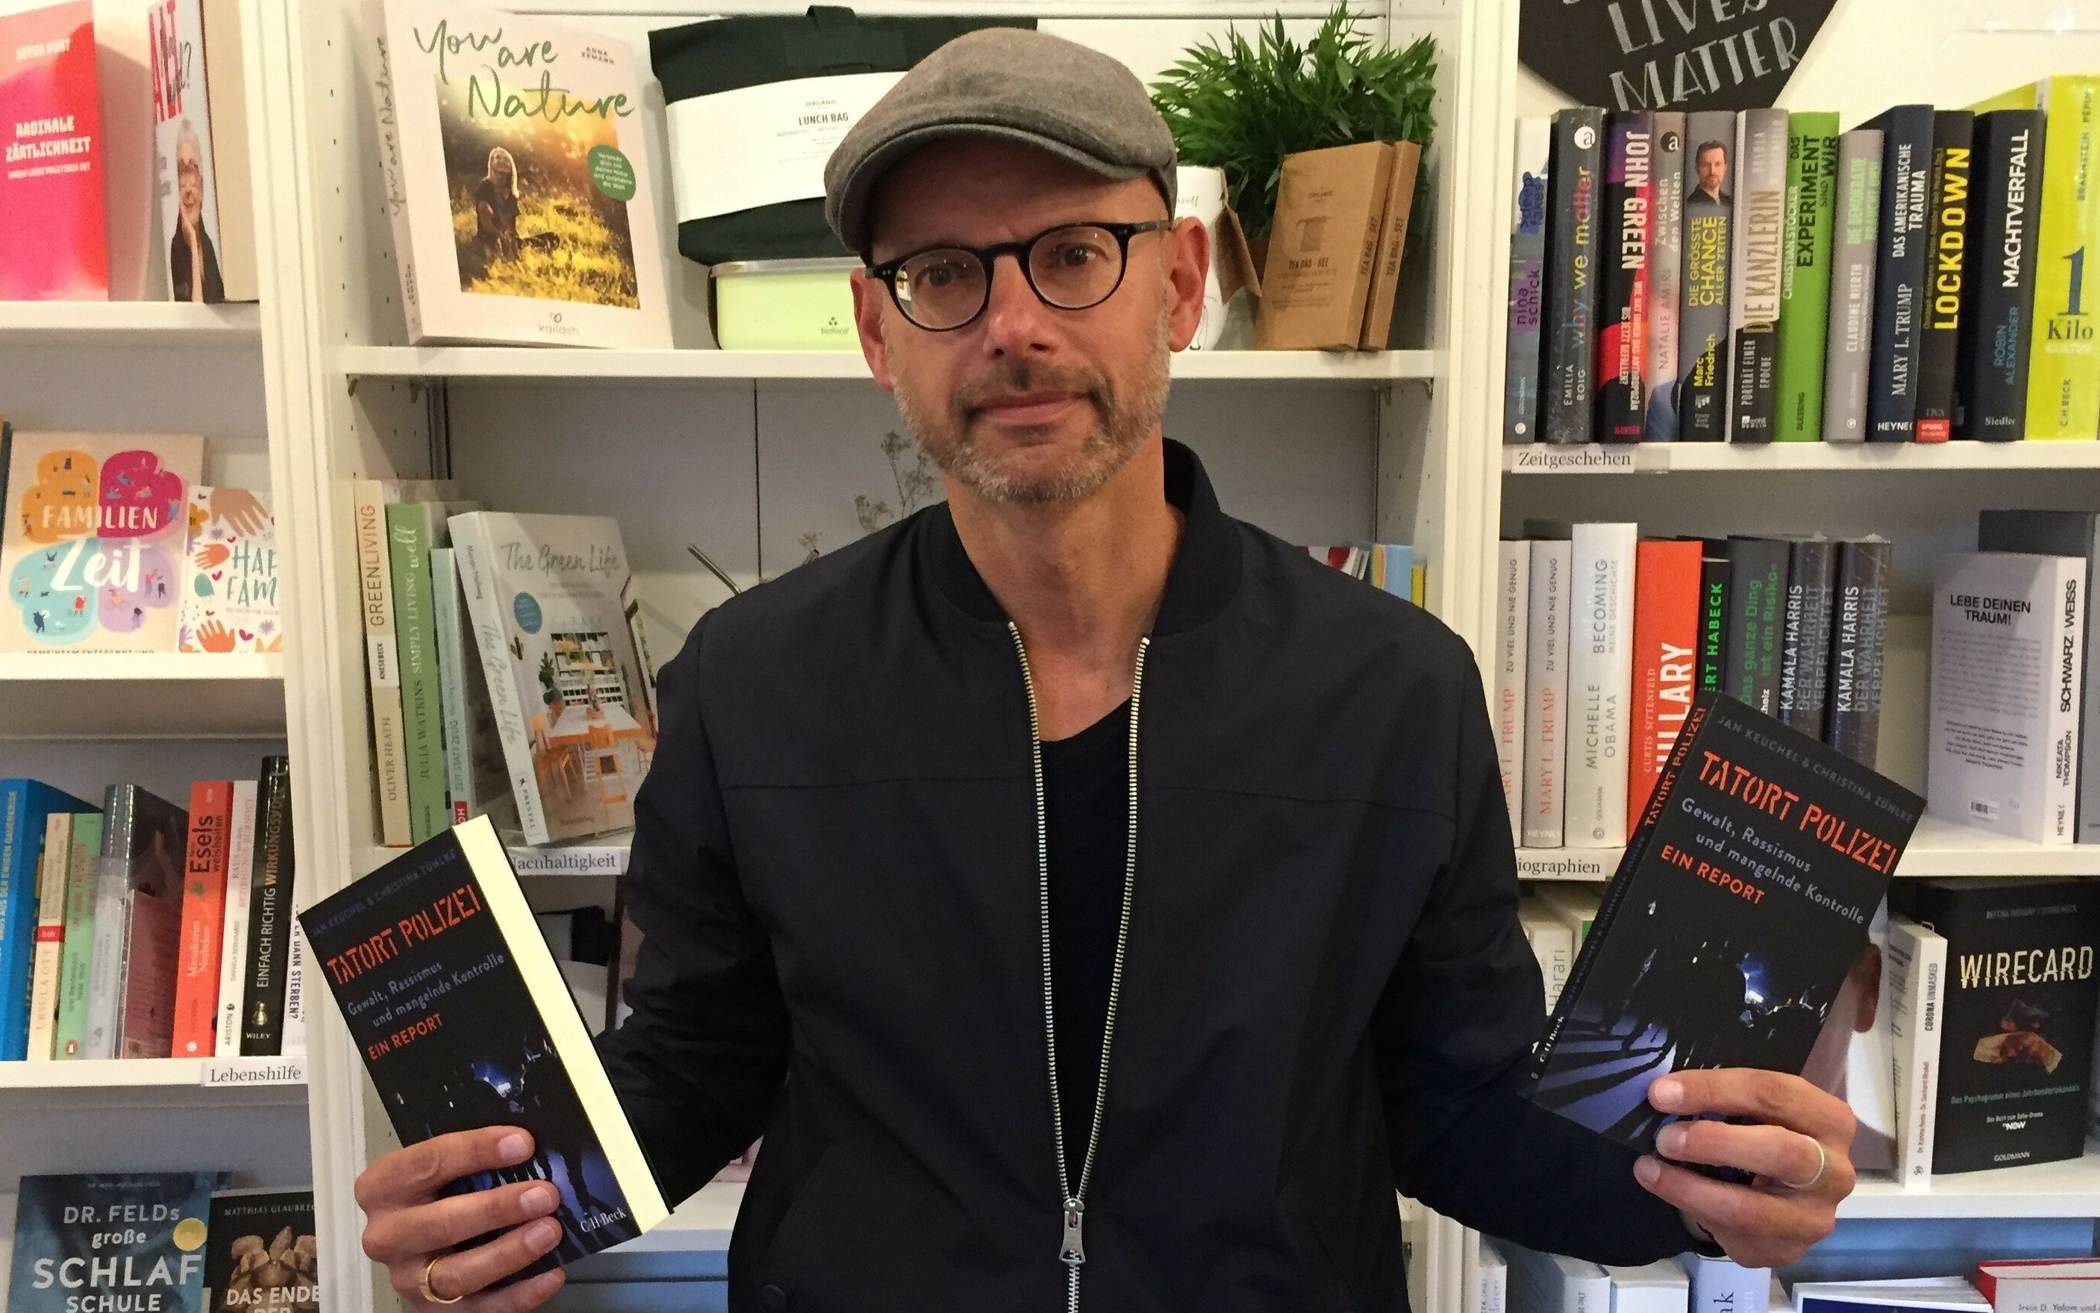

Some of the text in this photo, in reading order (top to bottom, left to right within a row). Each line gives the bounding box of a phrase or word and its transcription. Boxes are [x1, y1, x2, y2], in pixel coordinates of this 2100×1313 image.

[414, 19, 558, 84] You are
[1608, 16, 1801, 111] MATTER
[468, 65, 635, 122] Nature
[798, 112, 849, 126] LUNCH BAG
[1789, 135, 1801, 160] DAS
[1822, 135, 1837, 177] WIR
[1573, 166, 1592, 246] matter
[1621, 131, 1650, 270] JOHN GREEN
[1655, 178, 1669, 246] Zwischen
[1670, 171, 1682, 223] Welten
[1796, 134, 1820, 268] EXPERIMENT
[1892, 143, 1912, 258] DAS AMERIKANISCHE
[1908, 169, 1926, 231] TRAUMA
[2002, 129, 2029, 288] MACHTVERFALL
[1699, 215, 1718, 307] CHANCE
[1714, 215, 1728, 306] ALLER ZEITEN
[1744, 190, 1781, 297] KANZLERIN
[1934, 147, 1971, 330] LOCKDOWN
[1528, 269, 1541, 326] schick
[1574, 255, 1589, 290] we
[1688, 284, 1699, 307] DIE
[1782, 241, 1795, 300] CHRISTIAN
[2058, 246, 2088, 316] 1
[1516, 287, 1529, 325] nina
[1846, 302, 1861, 352] CLAUDINE
[1895, 283, 1913, 335] TRUMP
[2047, 318, 2094, 341] Kilo
[1658, 314, 1671, 370] NATALIE
[1704, 333, 1716, 387] Friedrich
[1743, 339, 1756, 366] EINER
[1993, 324, 2007, 368] ROBIN
[2004, 306, 2020, 386] ALEXANDER
[1564, 364, 1574, 406] EMILIA
[1577, 368, 1587, 401] ROIG
[1693, 357, 1704, 388] Marc
[1891, 354, 1909, 396] MARY
[1877, 422, 1909, 431] HEYNE
[1985, 416, 2016, 427] Siedler
[1518, 450, 1632, 469] Zeitgeschehen
[42, 504, 158, 530] FAMILIEN
[50, 533, 152, 593] Zeit
[499, 541, 621, 578] The Green Life
[393, 524, 422, 674] SIMPLY LIVING well
[1506, 558, 1518, 673] ZU VIEL UND NIE GENUG
[1546, 557, 1558, 672] ZU VIEL UND NIE GENUG
[1593, 558, 1609, 655] BECOMING
[1706, 583, 1723, 656] HABECK
[1747, 579, 1762, 617] Ding
[1950, 594, 2031, 614] LEBE DEINEN
[1965, 609, 2012, 626] TRAUM!
[1744, 621, 1758, 671] ganze
[1763, 626, 1775, 652] ein
[1780, 584, 1803, 711] KAMALA HARRIS
[1797, 585, 1820, 711] DER WAHRHEIT
[1837, 585, 1860, 712] KAMALA HARRIS
[2060, 578, 2077, 713] SCHWARZ WEISS
[414, 679, 431, 779] JULIA WATKINS
[1502, 687, 1515, 746] TRUMP
[1586, 683, 1600, 770] MICHELLE
[1604, 694, 1617, 758] OBAMA
[1716, 715, 1744, 737] JAN
[382, 717, 398, 802] OLIVER HEATH
[1539, 687, 1555, 816] MARY TRUMP
[1643, 735, 1654, 774] CURTIS
[1644, 707, 1707, 828] TATORT POLIZEI
[2055, 738, 2064, 780] NIKEATA
[2062, 730, 2073, 788] THOMPSON
[1680, 796, 1813, 874] Gewalt, Rassismus
[1699, 749, 1898, 876] TATORT POLIZEI
[190, 815, 213, 873] Esels
[211, 815, 224, 873] weisheiten
[1517, 857, 1602, 877] iographien
[1660, 844, 1766, 906] EIN REPORT
[1695, 832, 1865, 926] und mangelnde Kontrolle
[257, 887, 276, 988] EINFACH RICHTIG
[326, 884, 481, 985] TATORT POLIZEI
[288, 970, 302, 1020] STERBEN?
[347, 960, 443, 1017] Gewalt, Rassismus
[372, 951, 506, 1028] und mangelnde Kontrolle
[1960, 945, 2094, 990] WIRECARD
[1924, 962, 1938, 1032] CORONA UNMASKED
[224, 1013, 234, 1046] ARISTON
[246, 1031, 271, 1040] WILEY
[367, 1012, 444, 1061] EIN REPORT
[210, 1064, 302, 1083] Lebenshilfe
[63, 1203, 180, 1224] DR. FELDs
[92, 1228, 147, 1250] große
[32, 1253, 202, 1290] SCHLAF
[226, 1285, 321, 1306] DAS ENDE
[66, 1293, 162, 1313] SCHULE
